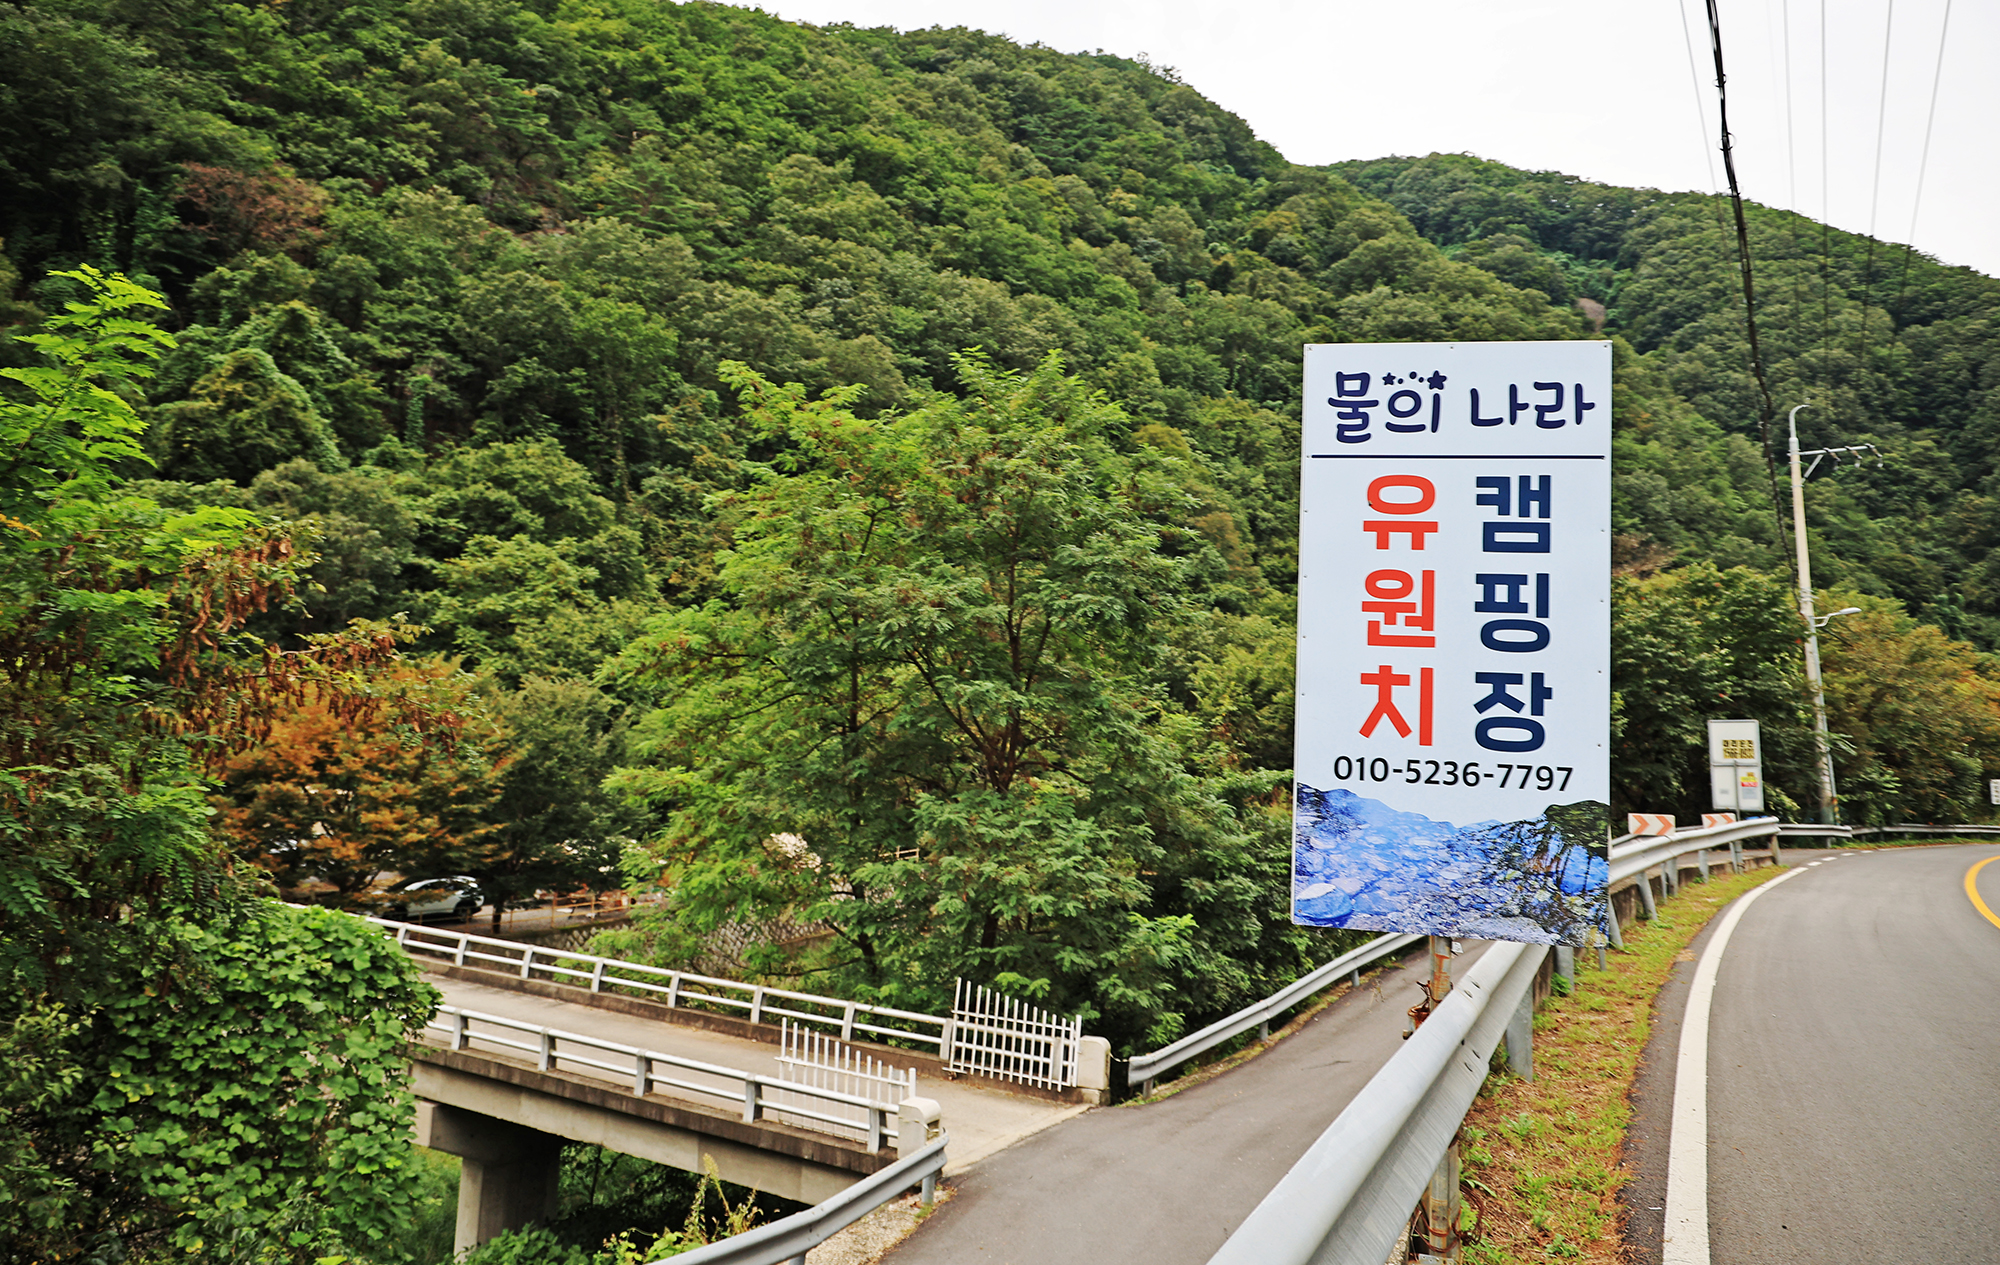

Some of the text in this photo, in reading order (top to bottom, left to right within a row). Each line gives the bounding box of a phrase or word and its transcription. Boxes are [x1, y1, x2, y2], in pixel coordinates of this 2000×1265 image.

[1328, 370, 1595, 443] 물의 나라
[1358, 474, 1439, 746] 유원치
[1473, 474, 1553, 752] 캠핑장
[1333, 755, 1574, 792] 010-5236-7797
